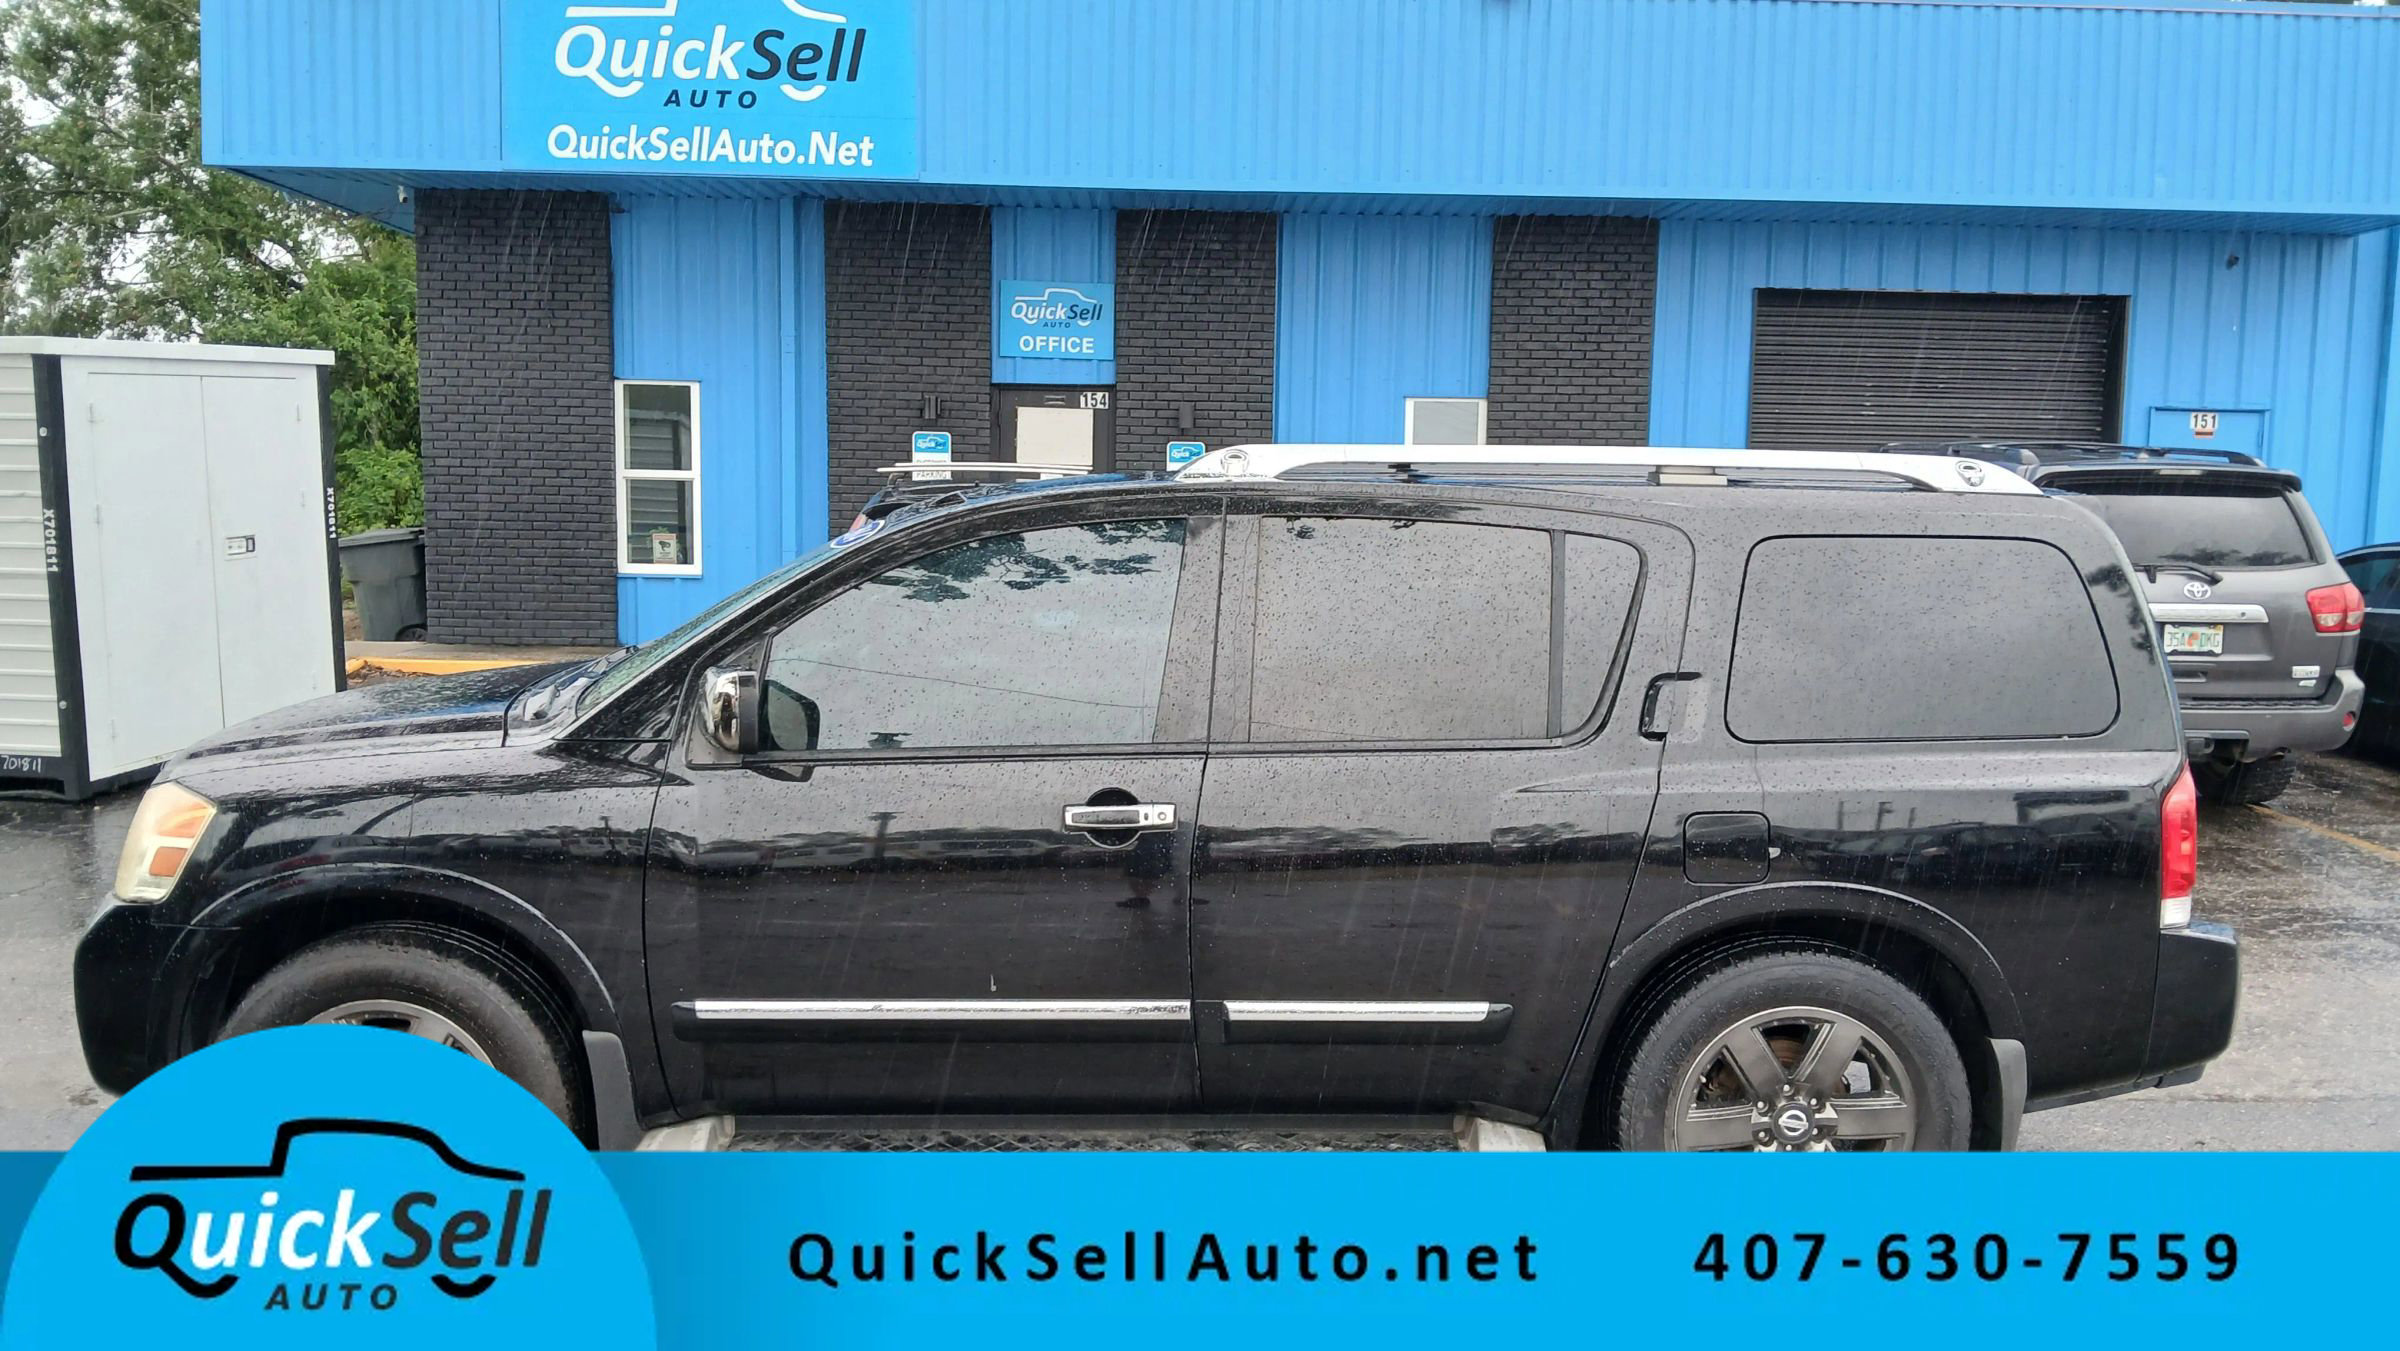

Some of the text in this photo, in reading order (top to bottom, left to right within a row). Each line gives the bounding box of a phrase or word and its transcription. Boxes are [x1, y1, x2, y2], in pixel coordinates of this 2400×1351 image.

[555, 24, 867, 98] QuickSell
[663, 88, 758, 109] AUTO
[547, 124, 874, 167] QuickSellAuto.Net
[1011, 301, 1103, 325] QuickSell
[1043, 321, 1071, 329] AUTO
[1019, 335, 1095, 354] OFFICE
[1082, 392, 1108, 408] 154
[2193, 413, 2217, 429] 151
[43, 508, 59, 573] X701811
[1, 755, 42, 773] 701811
